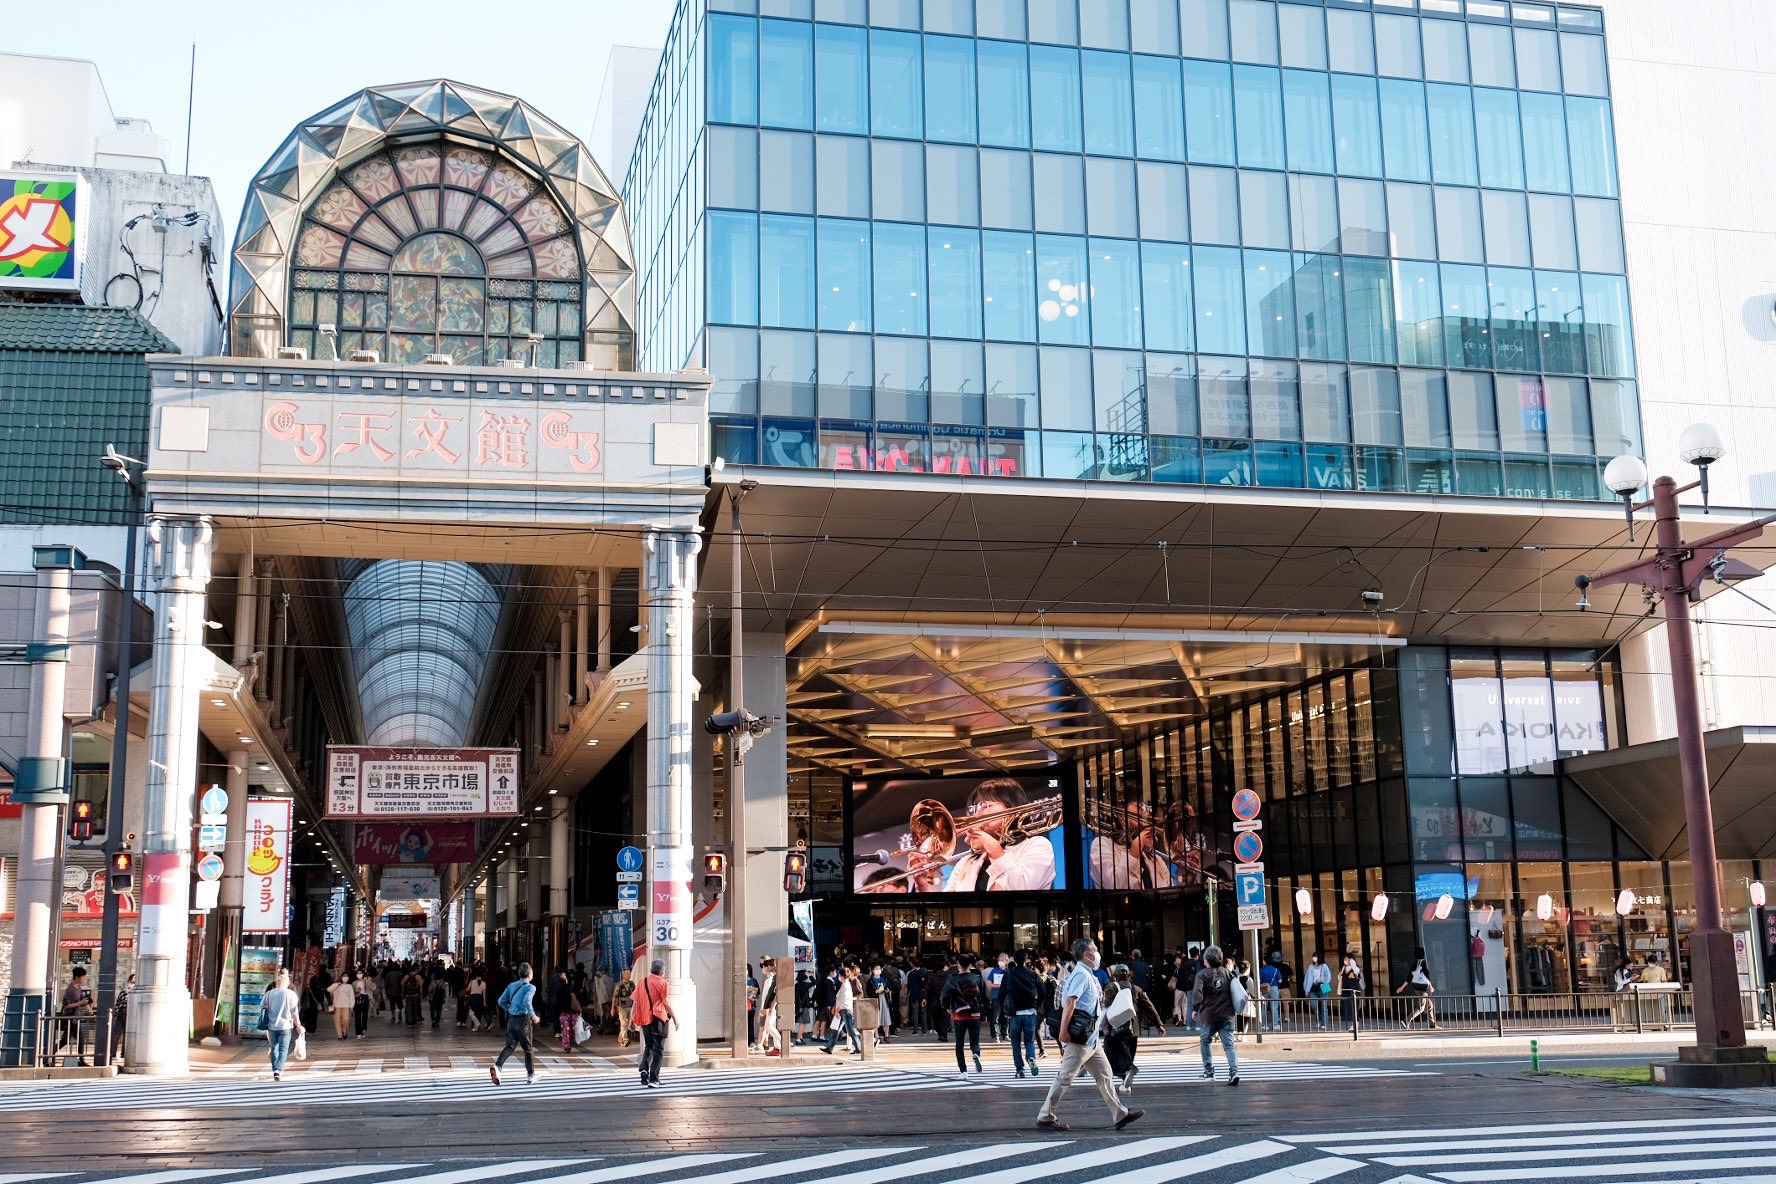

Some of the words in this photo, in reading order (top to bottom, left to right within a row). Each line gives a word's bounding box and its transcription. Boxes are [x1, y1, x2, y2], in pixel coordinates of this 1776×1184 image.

[332, 407, 532, 469] 天文館
[1313, 466, 1368, 490] VANS
[1556, 696, 1582, 706] RIVE
[384, 781, 401, 790] 専門
[385, 773, 401, 781] 買取
[403, 773, 479, 791] 東京市場
[1243, 876, 1259, 903] P
[656, 926, 679, 942] 30
